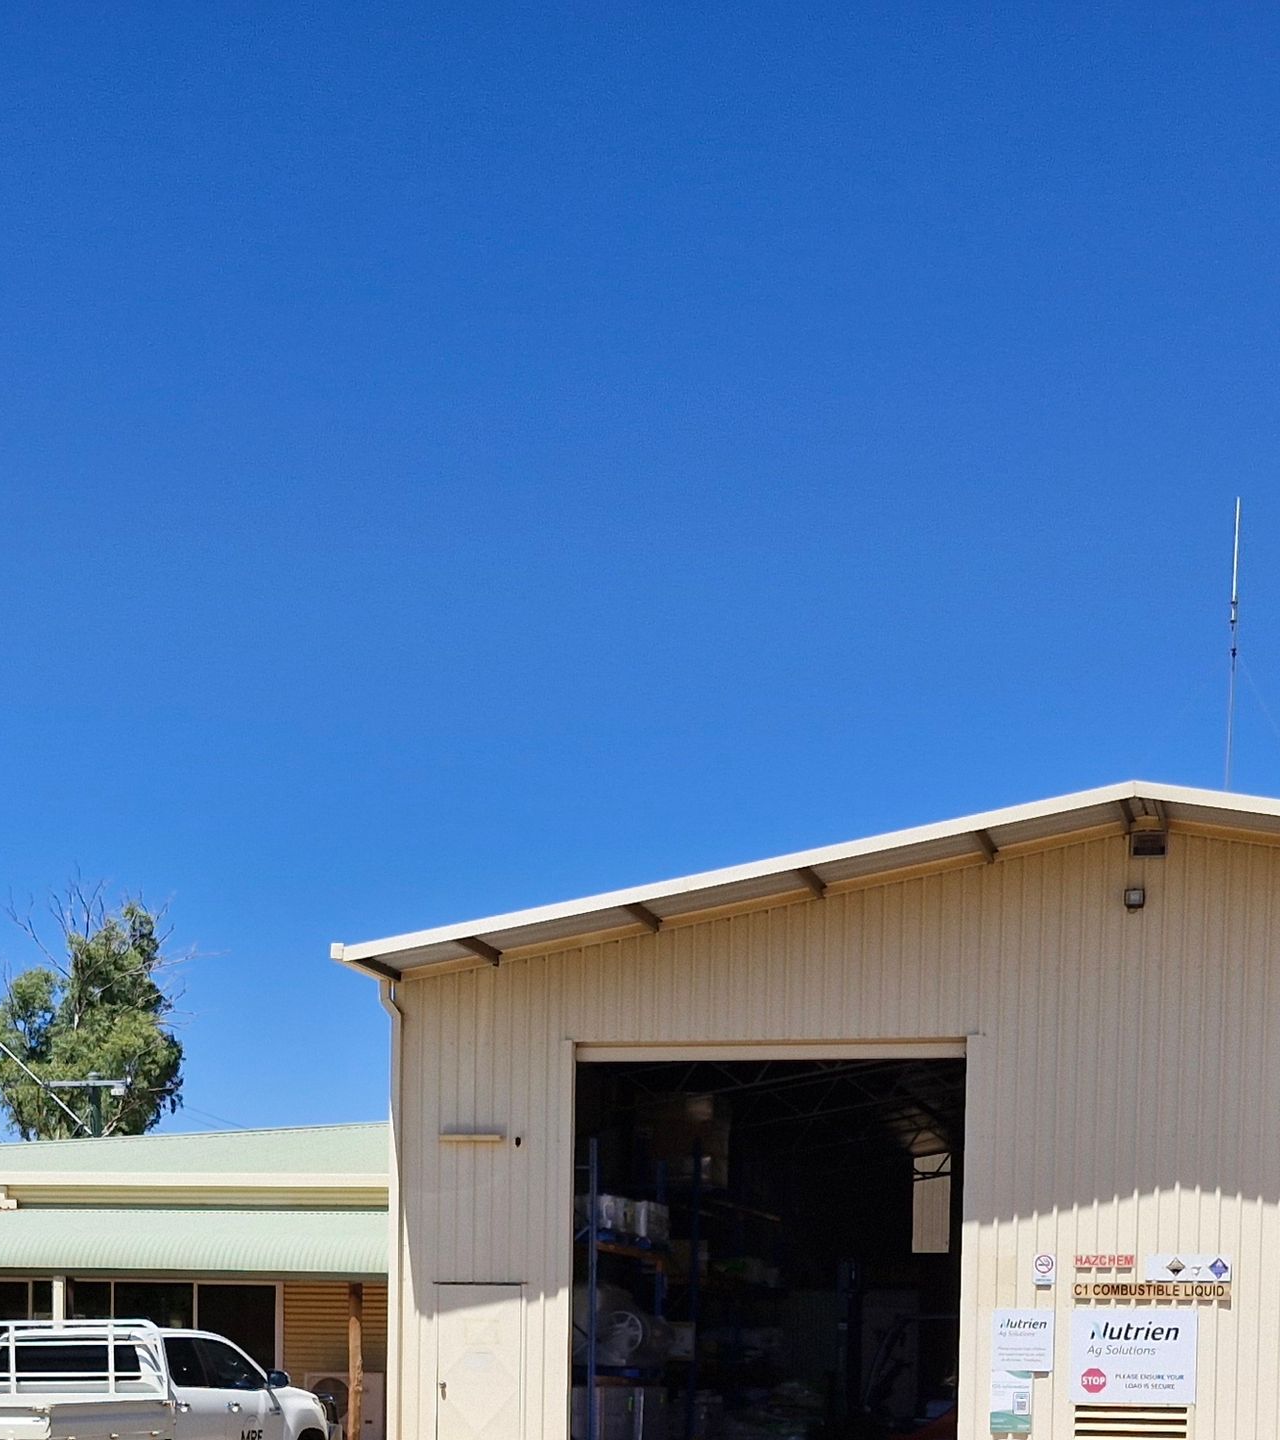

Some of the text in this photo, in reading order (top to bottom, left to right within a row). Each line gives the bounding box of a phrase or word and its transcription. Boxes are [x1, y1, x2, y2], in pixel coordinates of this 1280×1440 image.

[1075, 1255, 1134, 1266] HAZCHEM
[1074, 1284, 1225, 1297] C1 COMBUSTIBLE LIQUID
[1000, 1318, 1047, 1329] Nutrien
[1090, 1321, 1179, 1341] Nutrien
[1087, 1345, 1157, 1357] Ag Solutions
[1082, 1376, 1106, 1385] STOP
